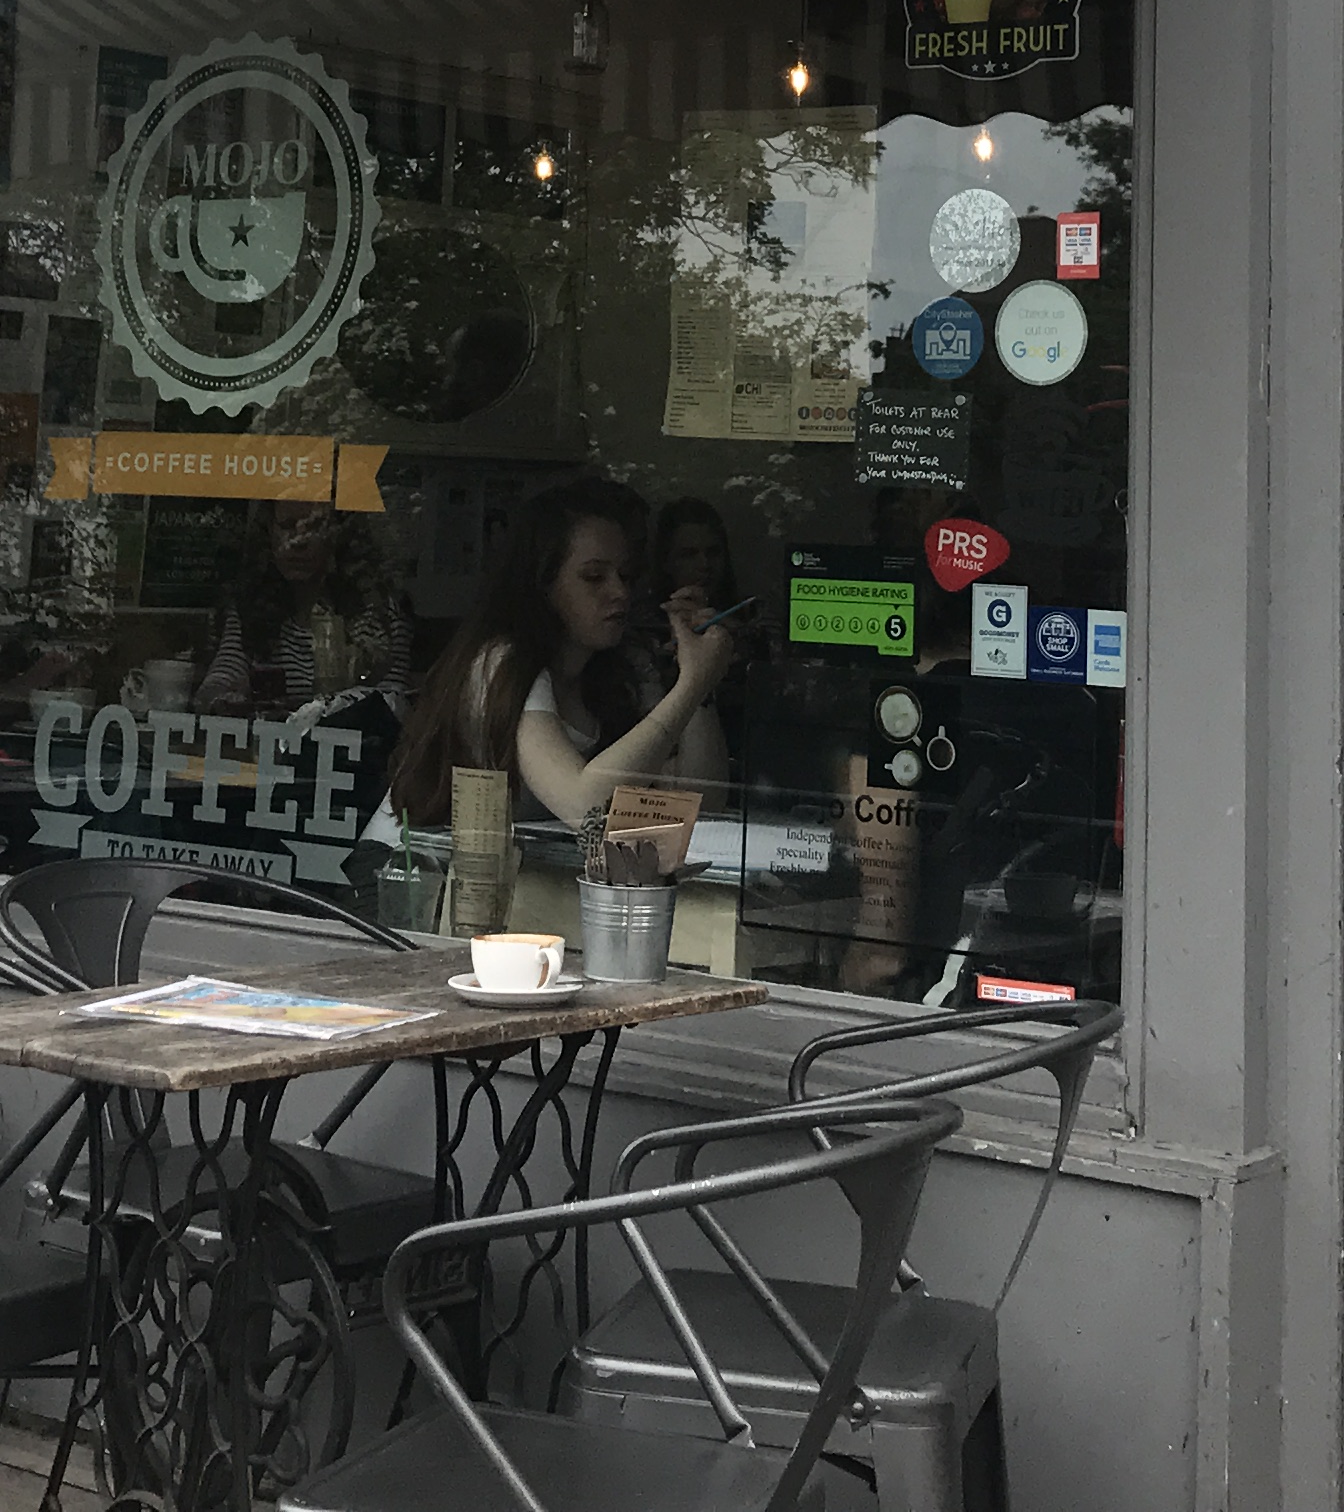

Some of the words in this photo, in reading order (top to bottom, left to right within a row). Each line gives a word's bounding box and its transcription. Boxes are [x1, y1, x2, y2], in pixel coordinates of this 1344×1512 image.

[914, 29, 989, 59] FRESH
[998, 22, 1070, 55] FRUIT
[179, 138, 308, 188] MOJO
[866, 398, 906, 419] TOILETS
[909, 406, 927, 420] AT
[930, 407, 960, 420] REAR
[868, 422, 887, 435] FOR
[936, 426, 956, 440] USE
[116, 451, 214, 476] COFFEE
[224, 454, 311, 479] HOUSE
[867, 451, 899, 464] THANK
[900, 453, 916, 466] YOU
[919, 455, 940, 467] FOR
[937, 527, 989, 560] PRS
[952, 557, 984, 572] MUSIC
[796, 583, 827, 595] FOOD
[828, 585, 873, 599] HYGIENE
[872, 587, 909, 600] RATING
[1045, 643, 1070, 652] SMALL
[1047, 636, 1068, 644] SHOP
[33, 699, 363, 842] COFFEE
